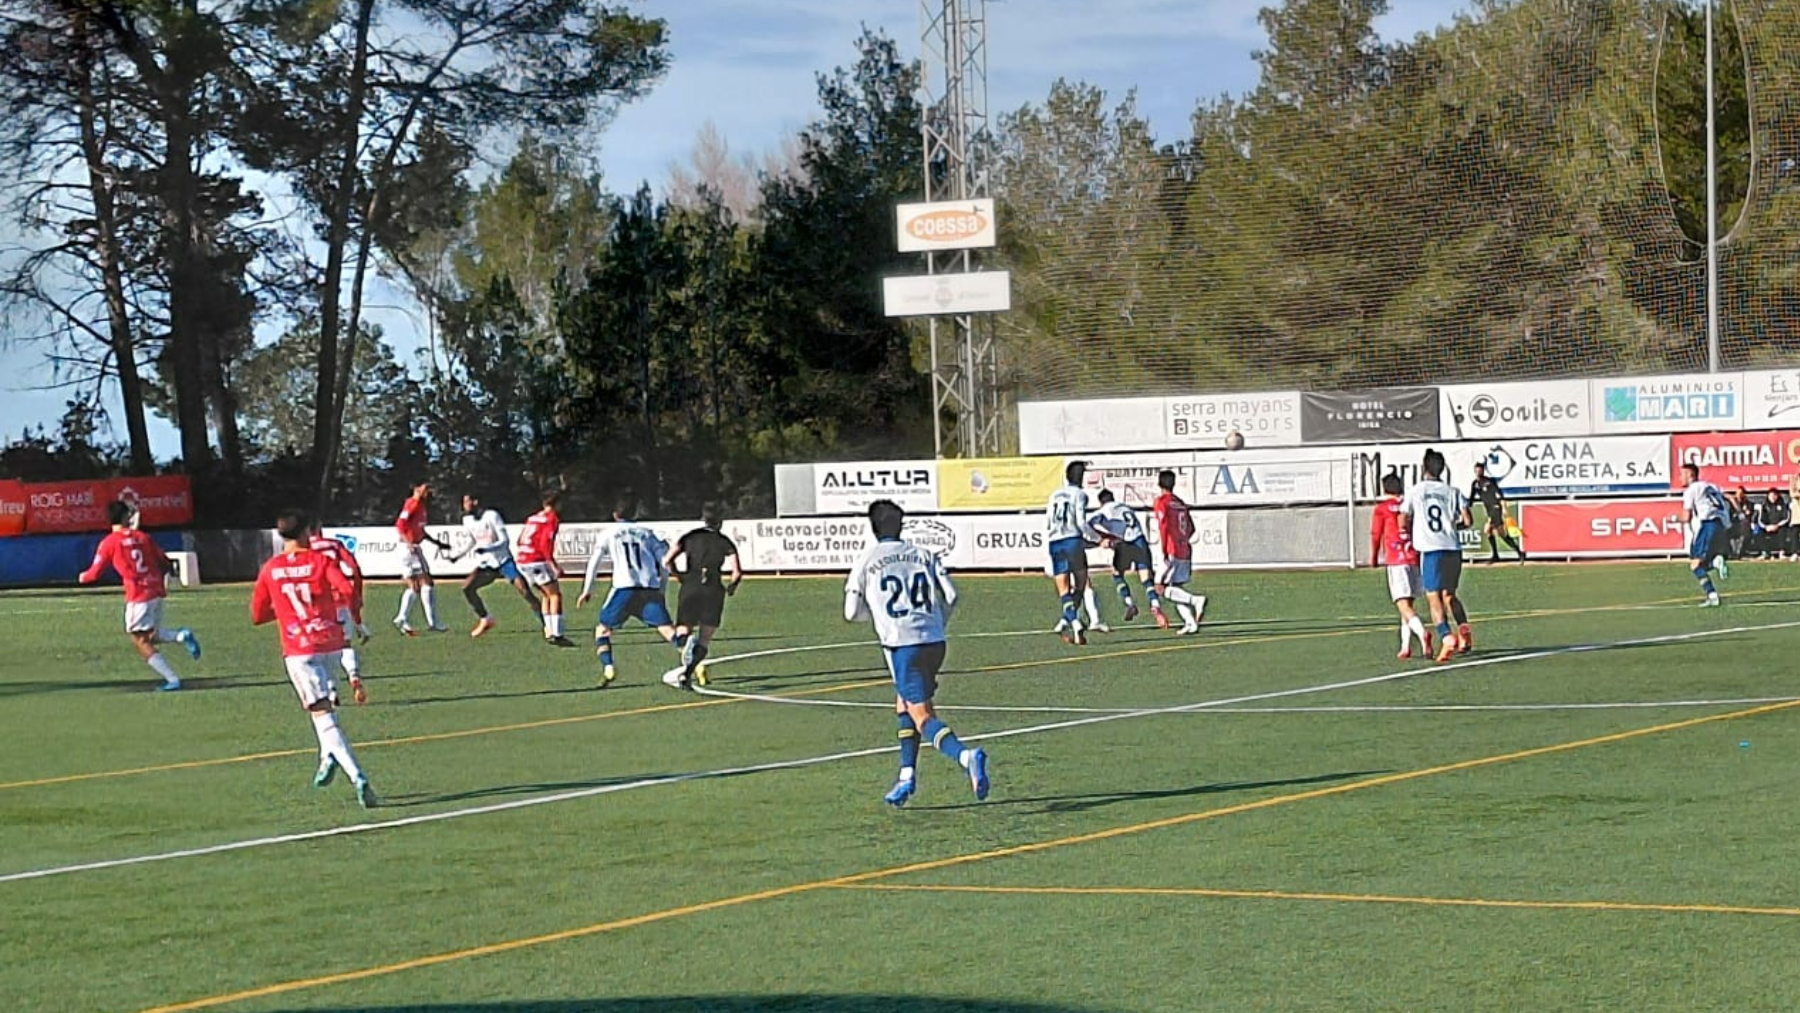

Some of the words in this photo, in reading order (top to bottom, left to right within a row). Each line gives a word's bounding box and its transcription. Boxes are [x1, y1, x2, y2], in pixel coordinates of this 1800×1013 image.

[913, 215, 978, 235] coessa
[1639, 382, 1734, 394] ALUMINIOS
[1172, 402, 1216, 416] serra
[1223, 398, 1293, 416] mayans
[1174, 417, 1294, 435] assessors
[822, 470, 930, 488] ALUTUR
[1525, 462, 1620, 480] NEGRETA,
[1626, 461, 1663, 477] S.A.
[1427, 505, 1442, 532] 8
[757, 522, 865, 537] Excavaciones
[783, 538, 820, 551] Lucas
[824, 537, 866, 551] Torres
[977, 532, 1042, 548] GRUAS
[131, 549, 148, 573] 2
[880, 571, 933, 618] 24
